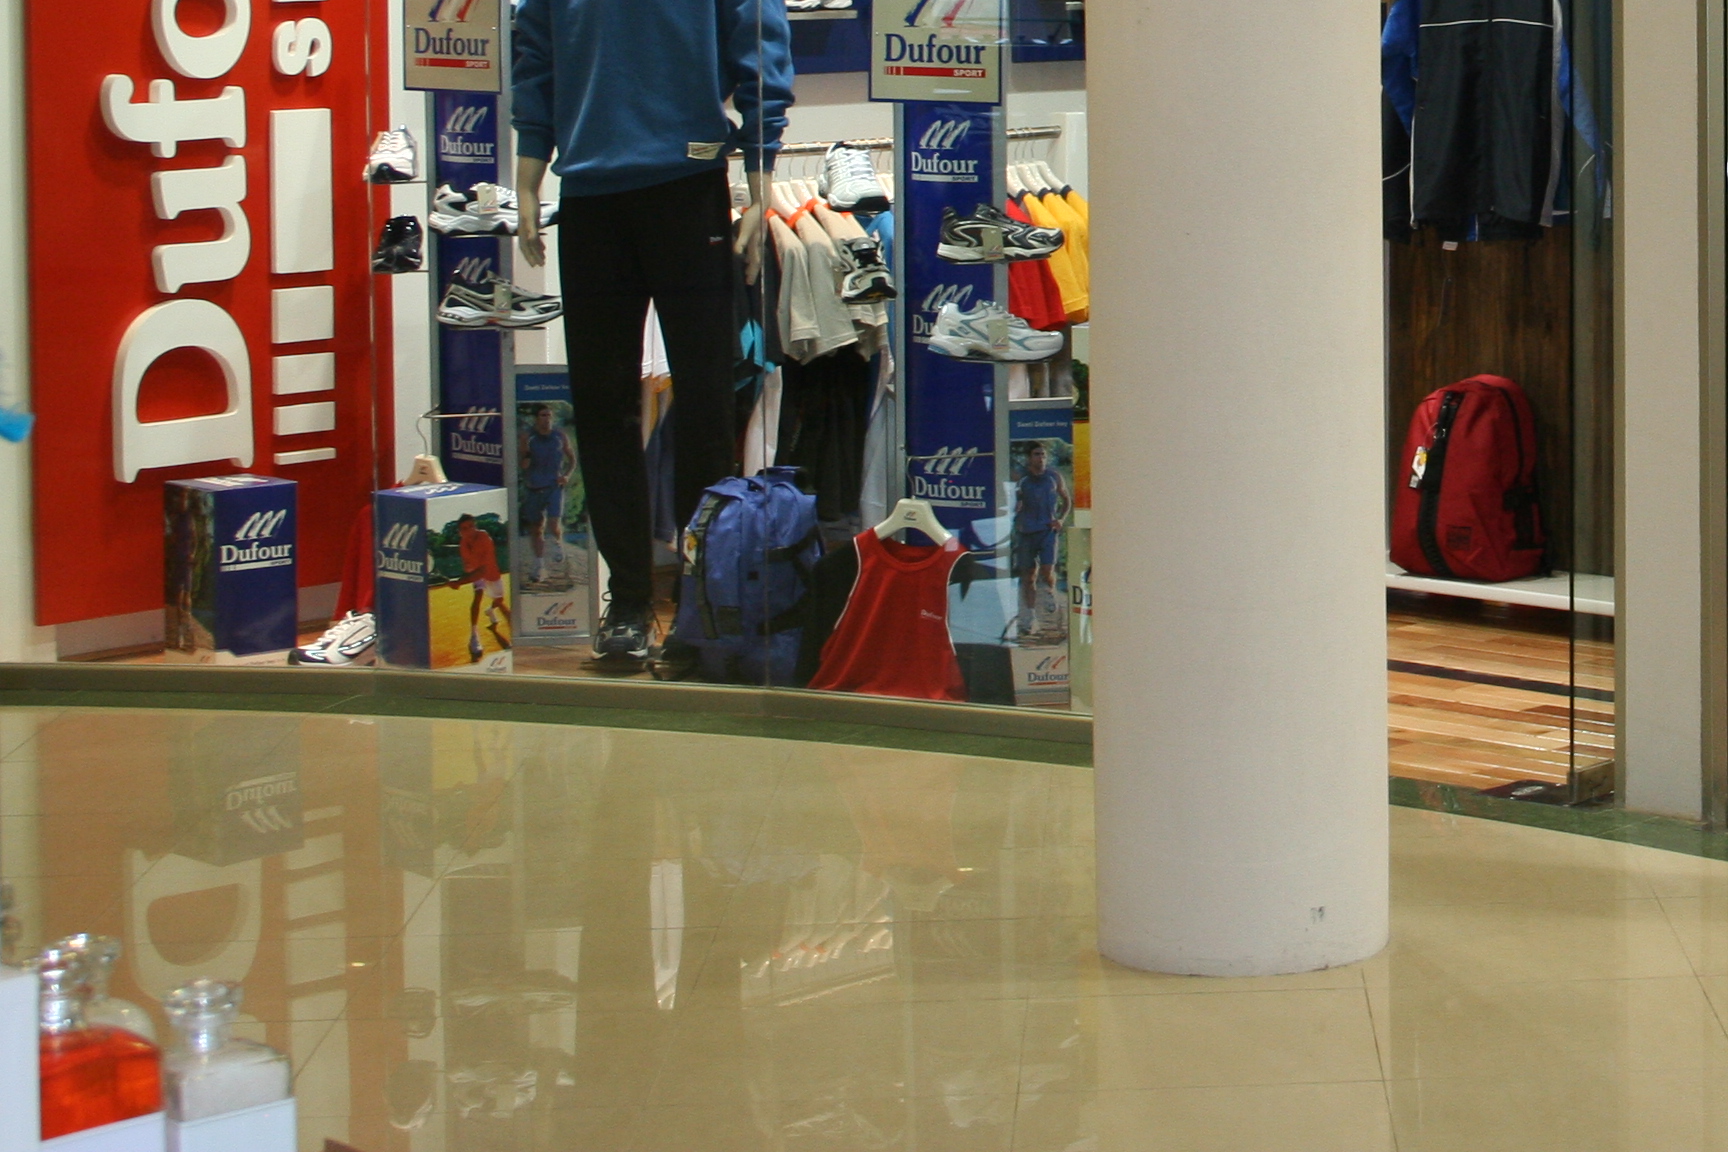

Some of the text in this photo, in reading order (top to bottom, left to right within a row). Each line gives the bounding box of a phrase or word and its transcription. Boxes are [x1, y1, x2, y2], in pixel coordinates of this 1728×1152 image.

[414, 27, 490, 57] Dufour
[884, 33, 987, 65] Dufour
[465, 59, 489, 69] SPORT
[953, 68, 985, 78] SPORT
[440, 134, 495, 156] Dufour
[911, 151, 979, 174] Dufour
[451, 432, 502, 456] Dufour
[915, 476, 986, 499] Dufour
[221, 542, 292, 564] Dufour
[377, 551, 424, 574] Dufour
[537, 616, 577, 626] Dufour
[1027, 672, 1069, 682] Dufour
